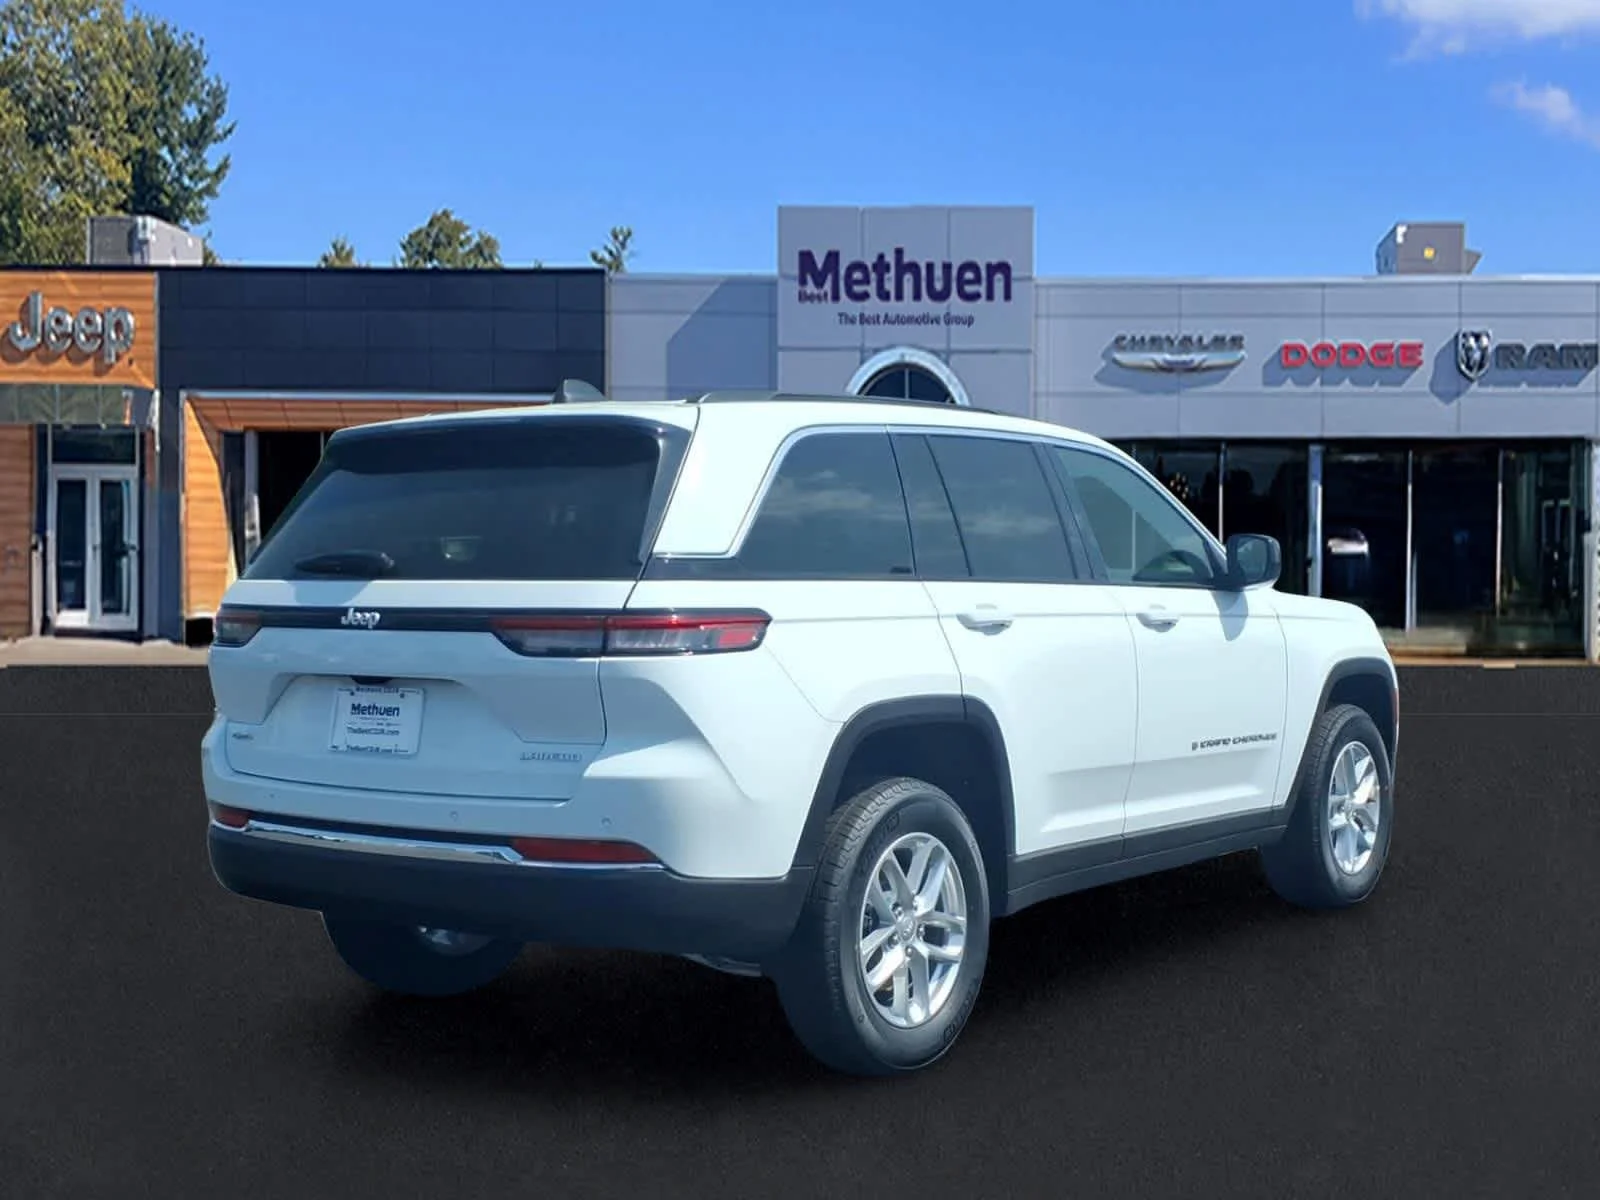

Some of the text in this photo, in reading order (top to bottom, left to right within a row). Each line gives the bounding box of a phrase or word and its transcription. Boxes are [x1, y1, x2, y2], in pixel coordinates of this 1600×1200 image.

[798, 247, 1012, 304] Methuen
[9, 290, 136, 365] Jeep
[838, 311, 974, 329] The Best Automotive Group
[1114, 333, 1245, 351] CHRYSLER
[1281, 342, 1424, 368] DODGE
[1495, 342, 1599, 370] RAM
[340, 607, 381, 630] Jeep
[351, 703, 400, 717] Methuen
